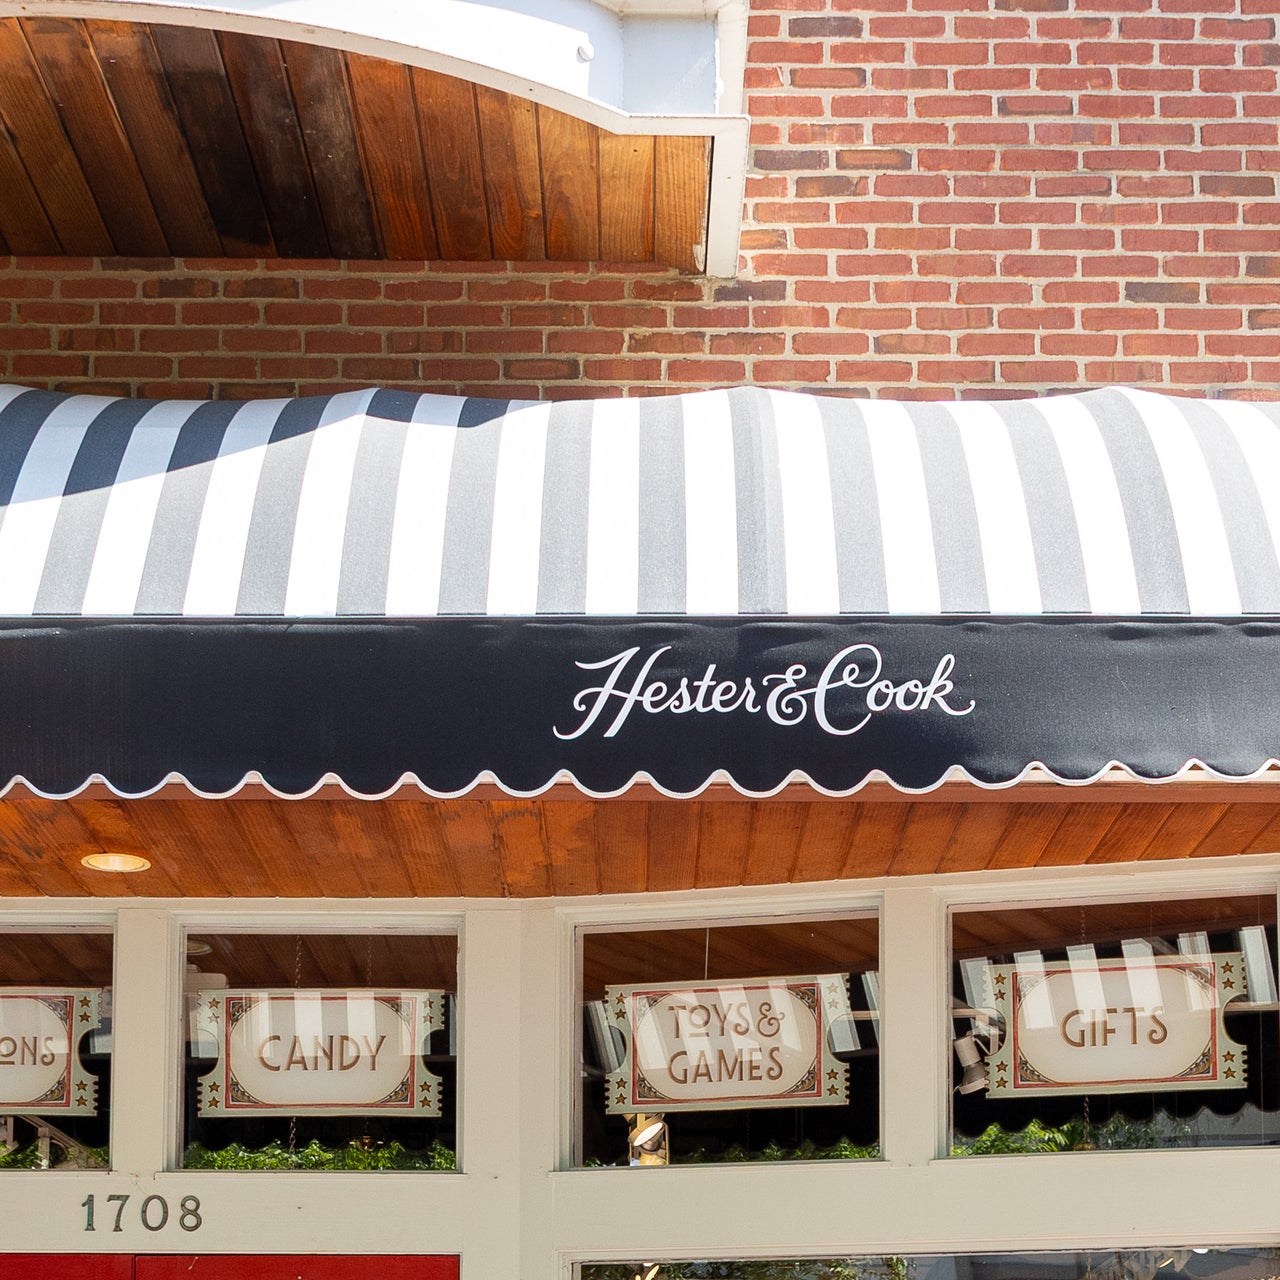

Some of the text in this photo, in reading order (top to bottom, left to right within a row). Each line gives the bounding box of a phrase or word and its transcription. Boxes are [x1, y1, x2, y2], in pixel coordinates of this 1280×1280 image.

[1059, 1005, 1170, 1048] GIFTS
[257, 1034, 388, 1073] CANDY
[668, 1046, 784, 1085] GAMES
[81, 1194, 203, 1233] 1708
